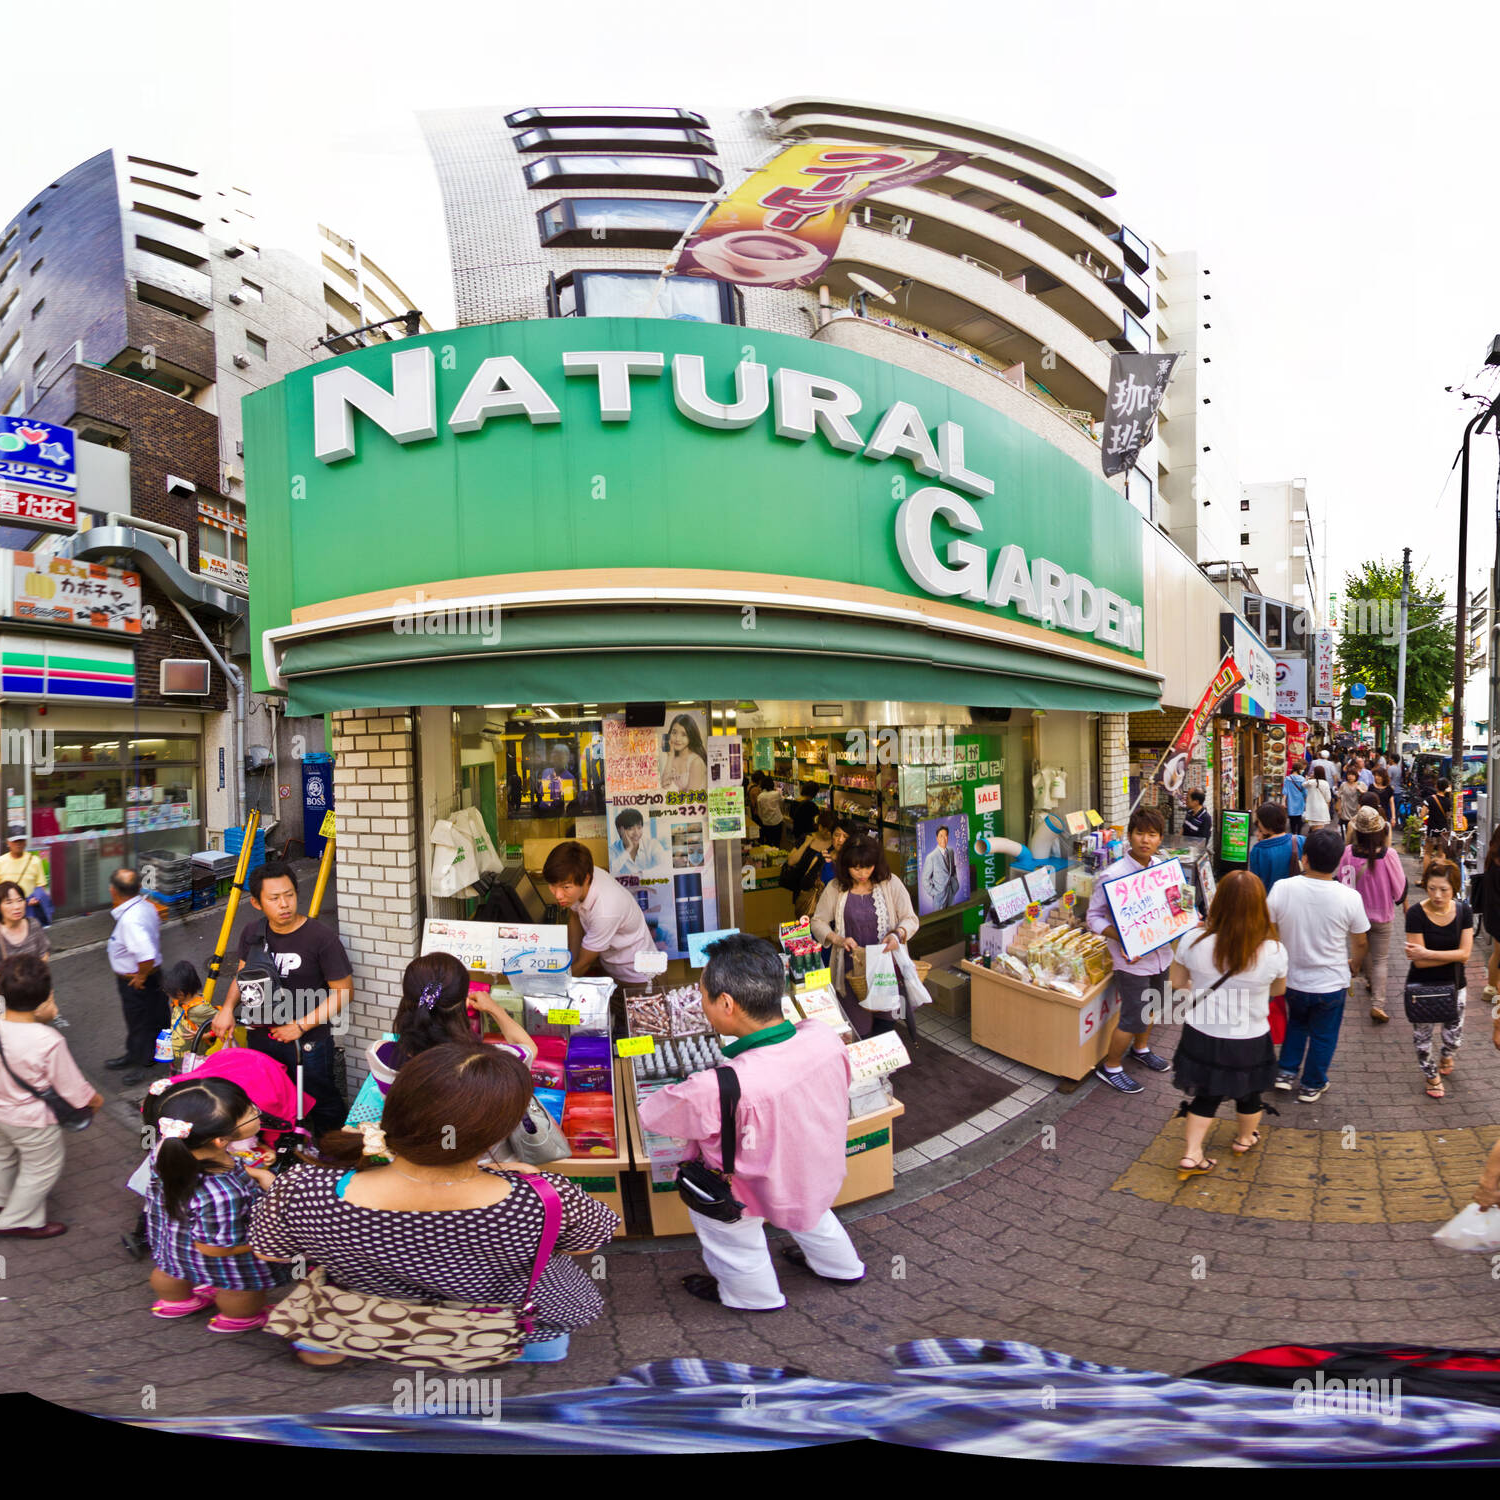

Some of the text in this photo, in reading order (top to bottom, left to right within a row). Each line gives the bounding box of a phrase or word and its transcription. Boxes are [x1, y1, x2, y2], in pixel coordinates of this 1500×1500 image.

[313, 346, 994, 498] NATURAL
[895, 487, 1143, 652] GARDEN
[307, 797, 326, 806] BOSS
[978, 791, 998, 804] SALE
[678, 805, 706, 816] マスク
